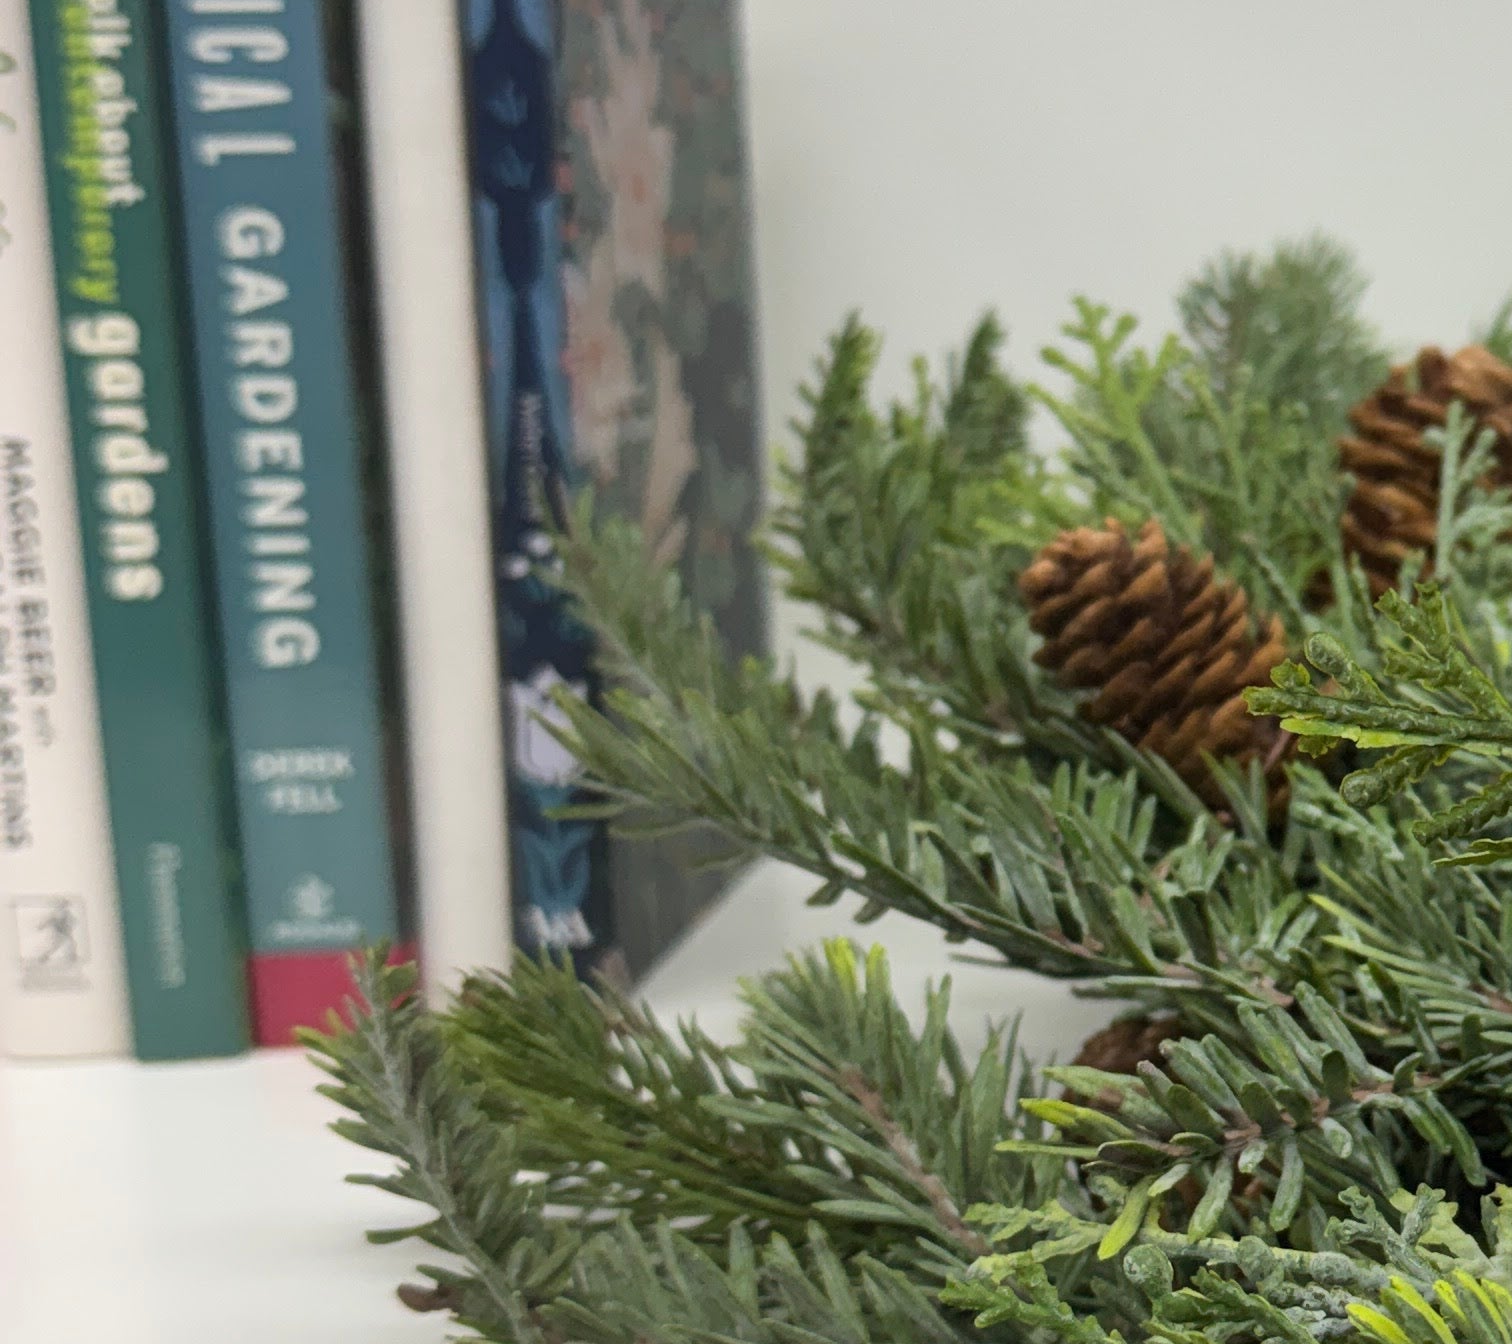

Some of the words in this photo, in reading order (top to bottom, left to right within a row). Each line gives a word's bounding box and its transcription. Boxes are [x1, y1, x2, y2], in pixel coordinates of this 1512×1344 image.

[93, 67, 146, 206] about
[69, 310, 168, 603] gardens
[220, 205, 320, 670] GARDENING
[1, 439, 47, 586] MAGGIE
[19, 599, 57, 696] BEER
